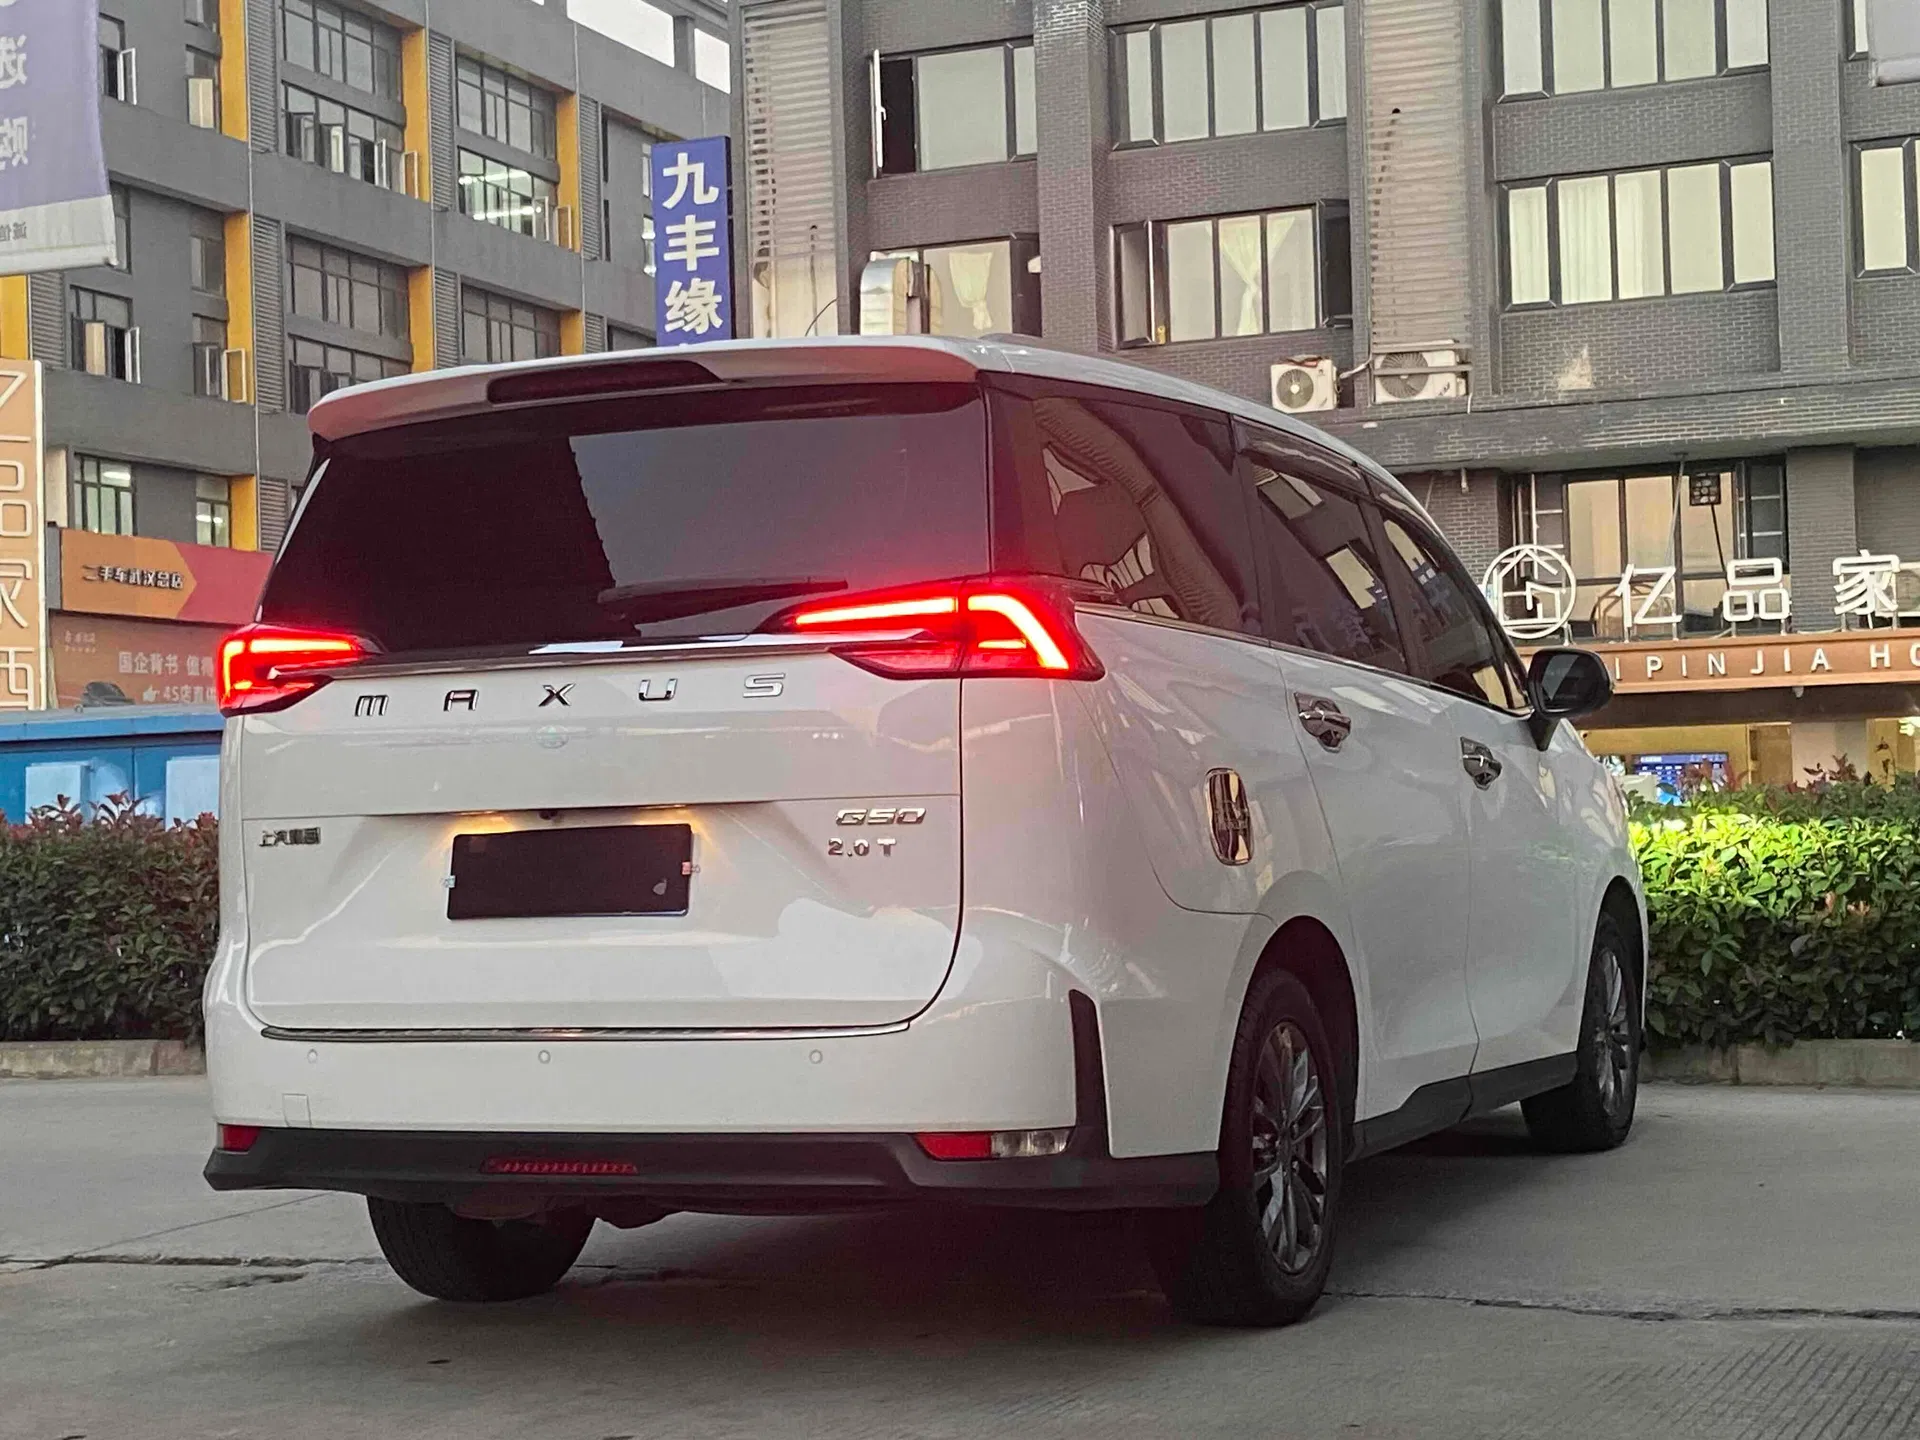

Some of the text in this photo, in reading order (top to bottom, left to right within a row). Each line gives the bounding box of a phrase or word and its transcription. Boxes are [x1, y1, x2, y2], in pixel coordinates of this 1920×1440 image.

[662, 152, 724, 347] 九丰缘
[1614, 549, 1901, 630] 亿品家
[1614, 647, 1832, 680] IPINJIA
[354, 672, 786, 717] MAXUS
[836, 807, 927, 826] G50
